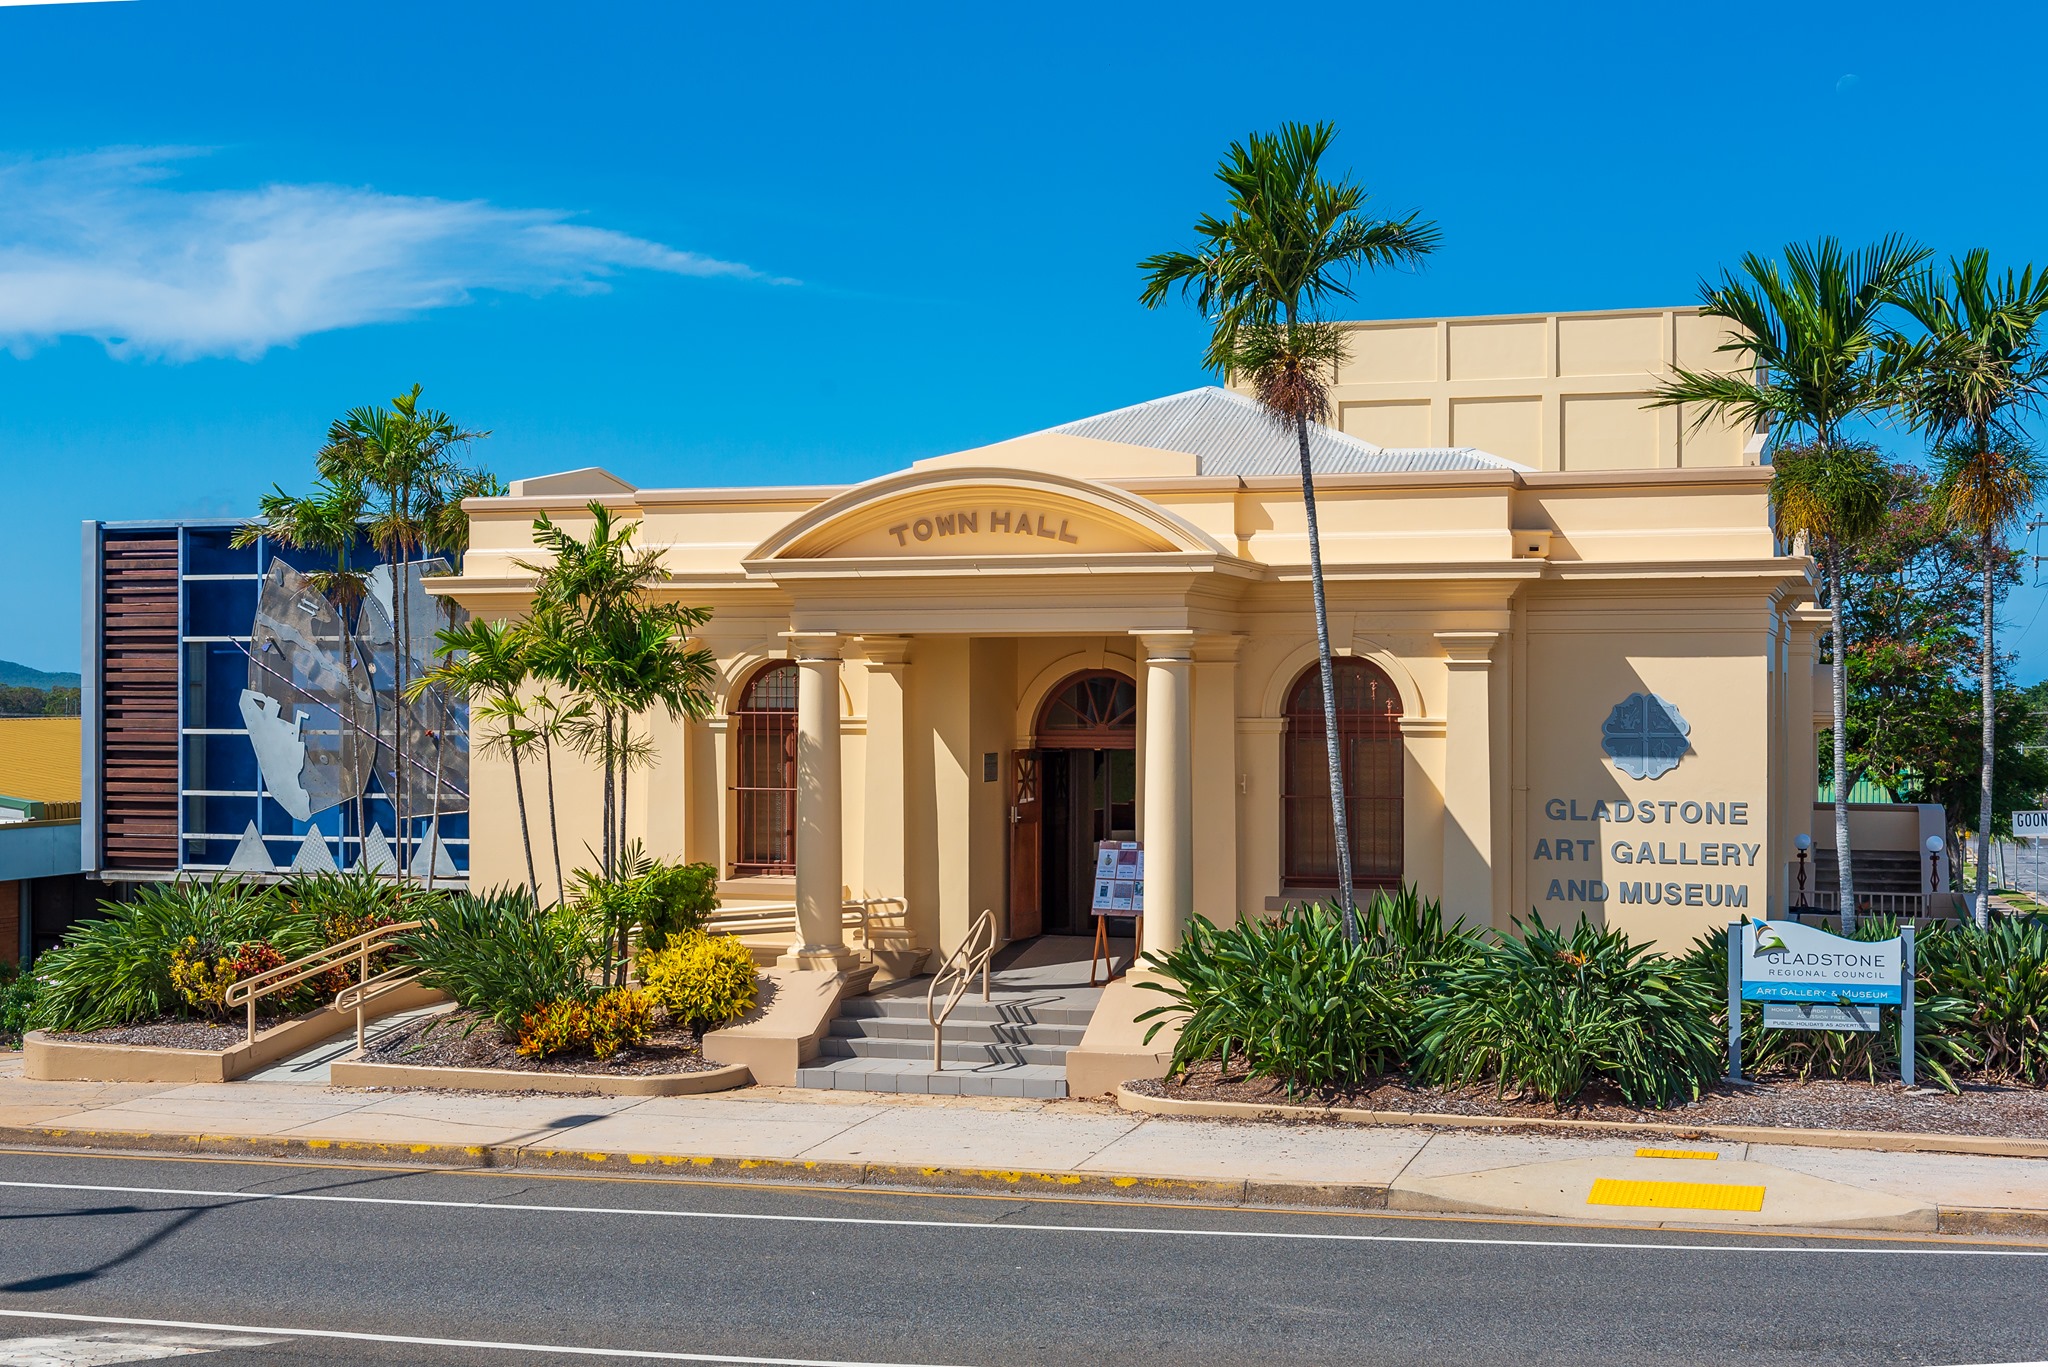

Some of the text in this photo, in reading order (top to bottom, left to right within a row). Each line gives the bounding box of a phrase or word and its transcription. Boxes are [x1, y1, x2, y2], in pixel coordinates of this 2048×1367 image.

[888, 511, 1078, 547] TOWN HALL
[1545, 798, 1748, 825] GLADSTONE
[1533, 838, 1760, 866] ART GALLERY
[1546, 879, 1748, 907] AND MUSEUM
[1767, 952, 1885, 967] GLADSTONE
[1768, 969, 1885, 979] REGIONAL COUNCIL
[1756, 987, 1777, 996] ART
[1780, 987, 1827, 997] GALLERY
[1842, 989, 1888, 999] MUSEUM
